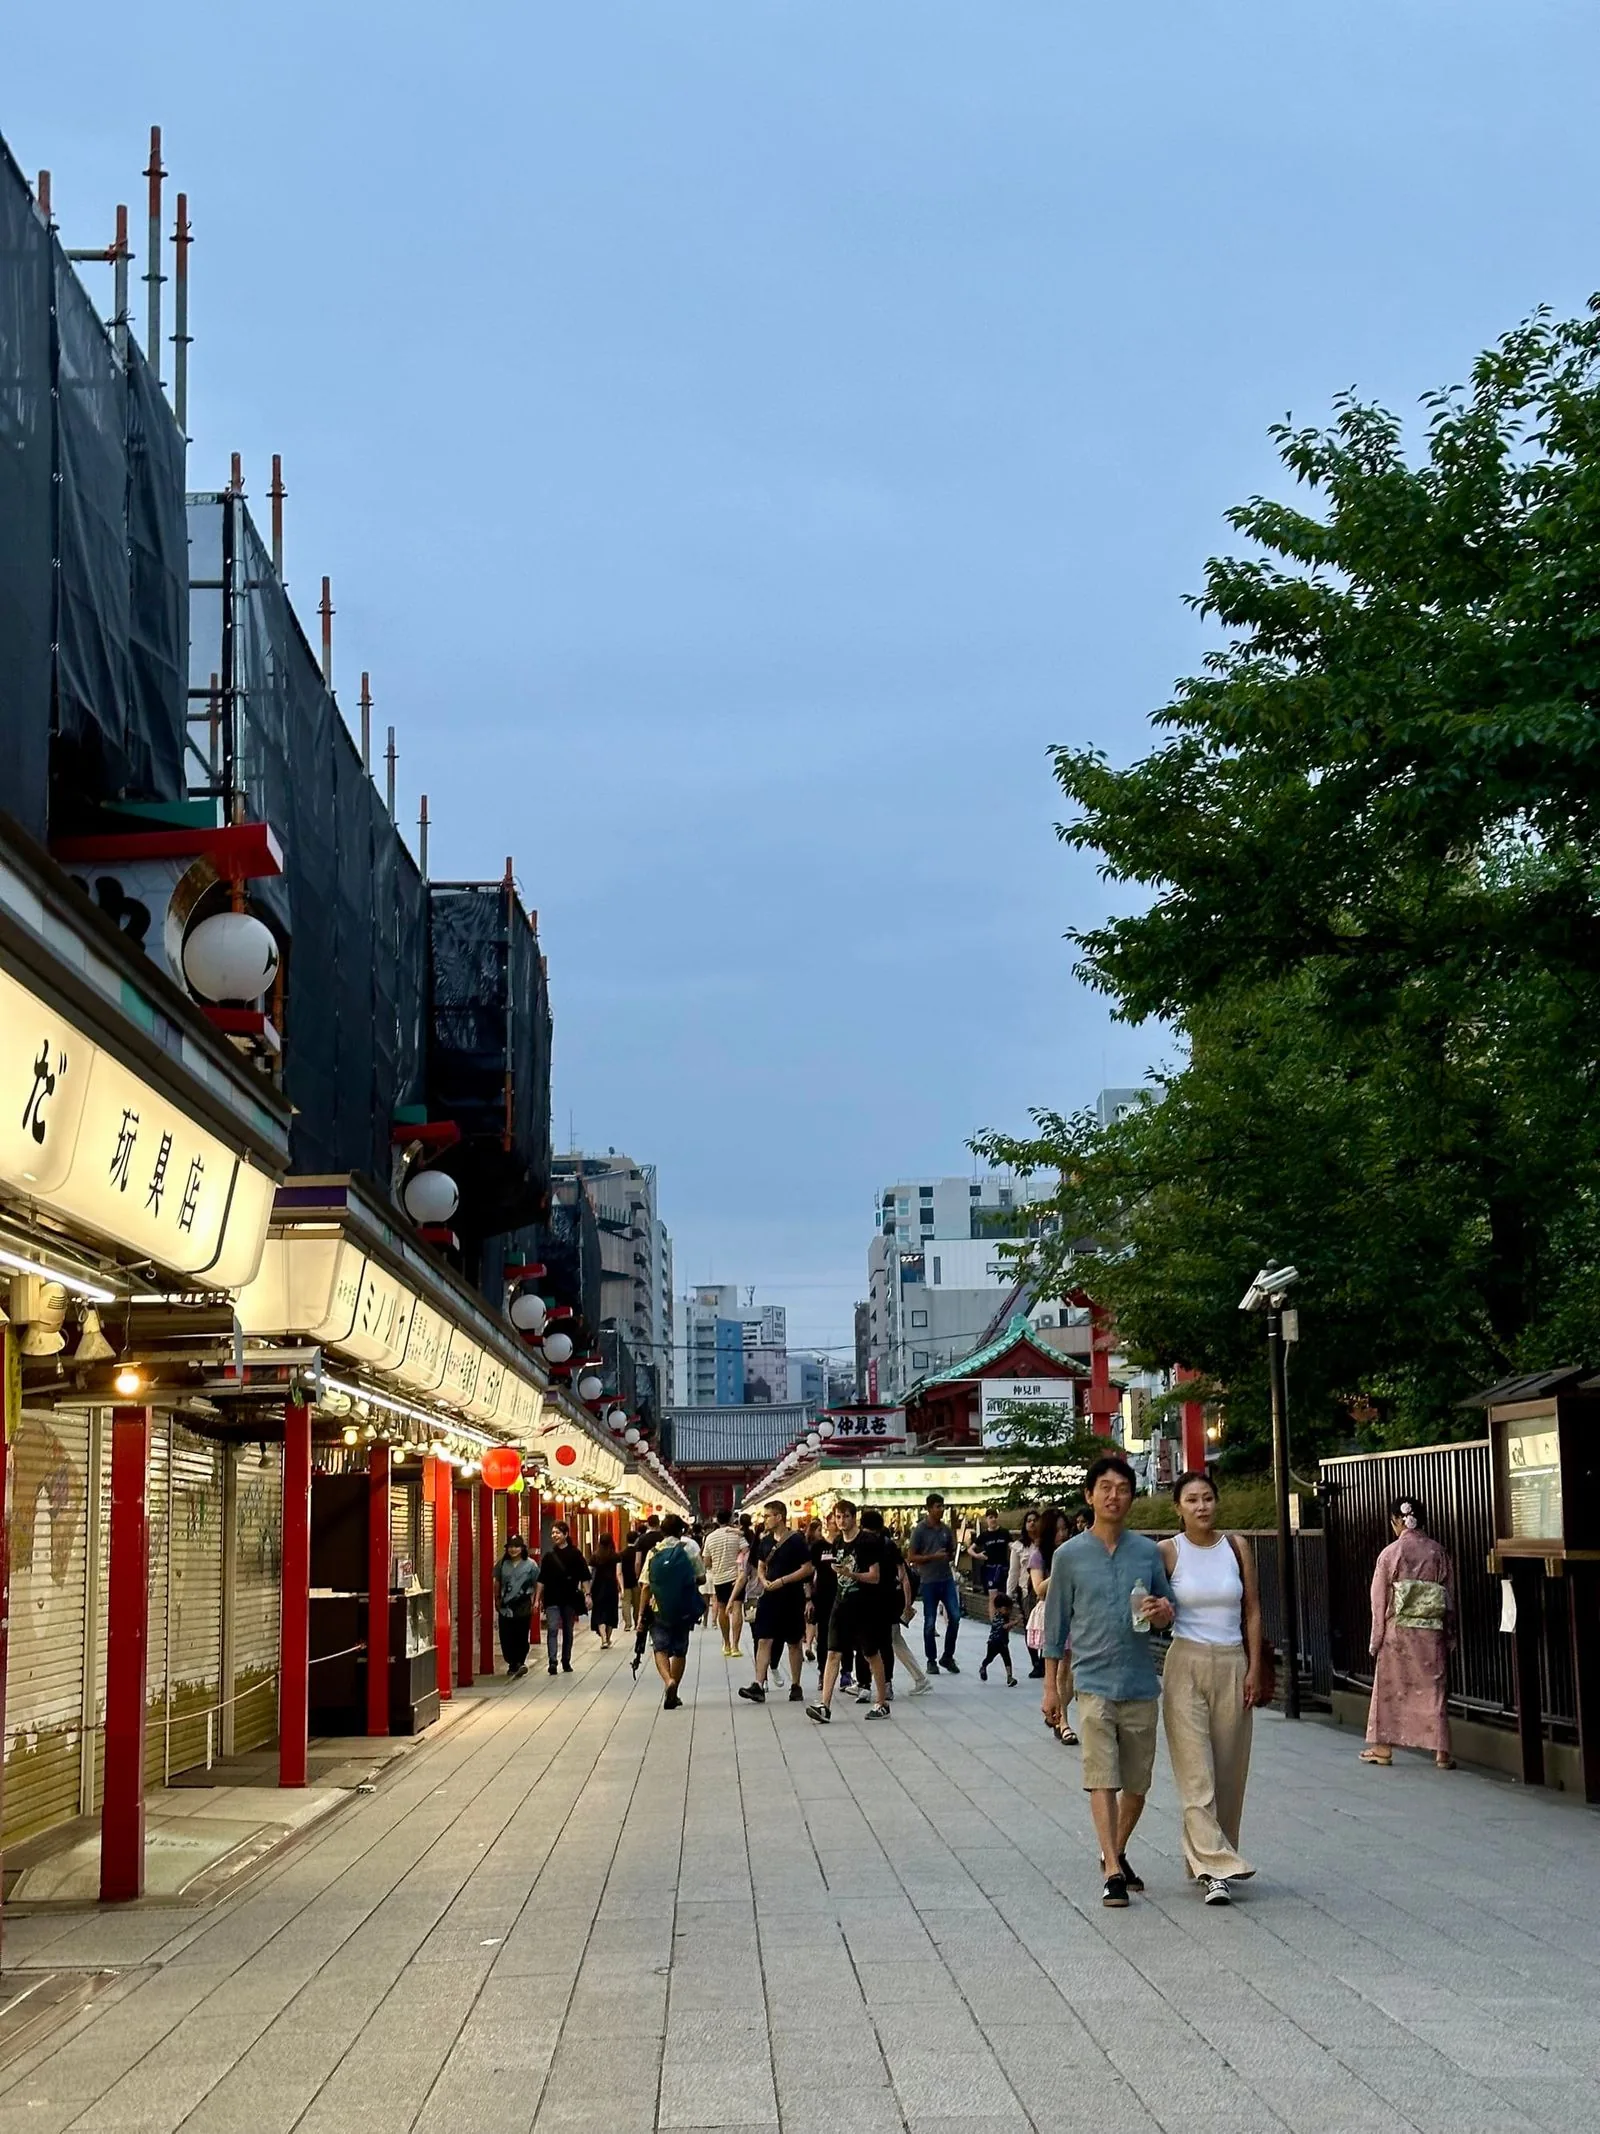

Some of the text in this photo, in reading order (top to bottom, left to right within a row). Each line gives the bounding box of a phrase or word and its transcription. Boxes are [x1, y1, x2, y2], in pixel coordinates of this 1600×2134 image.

[22, 1038, 205, 1234] だ 玩具店
[1013, 1385, 1041, 1396] 仲見世
